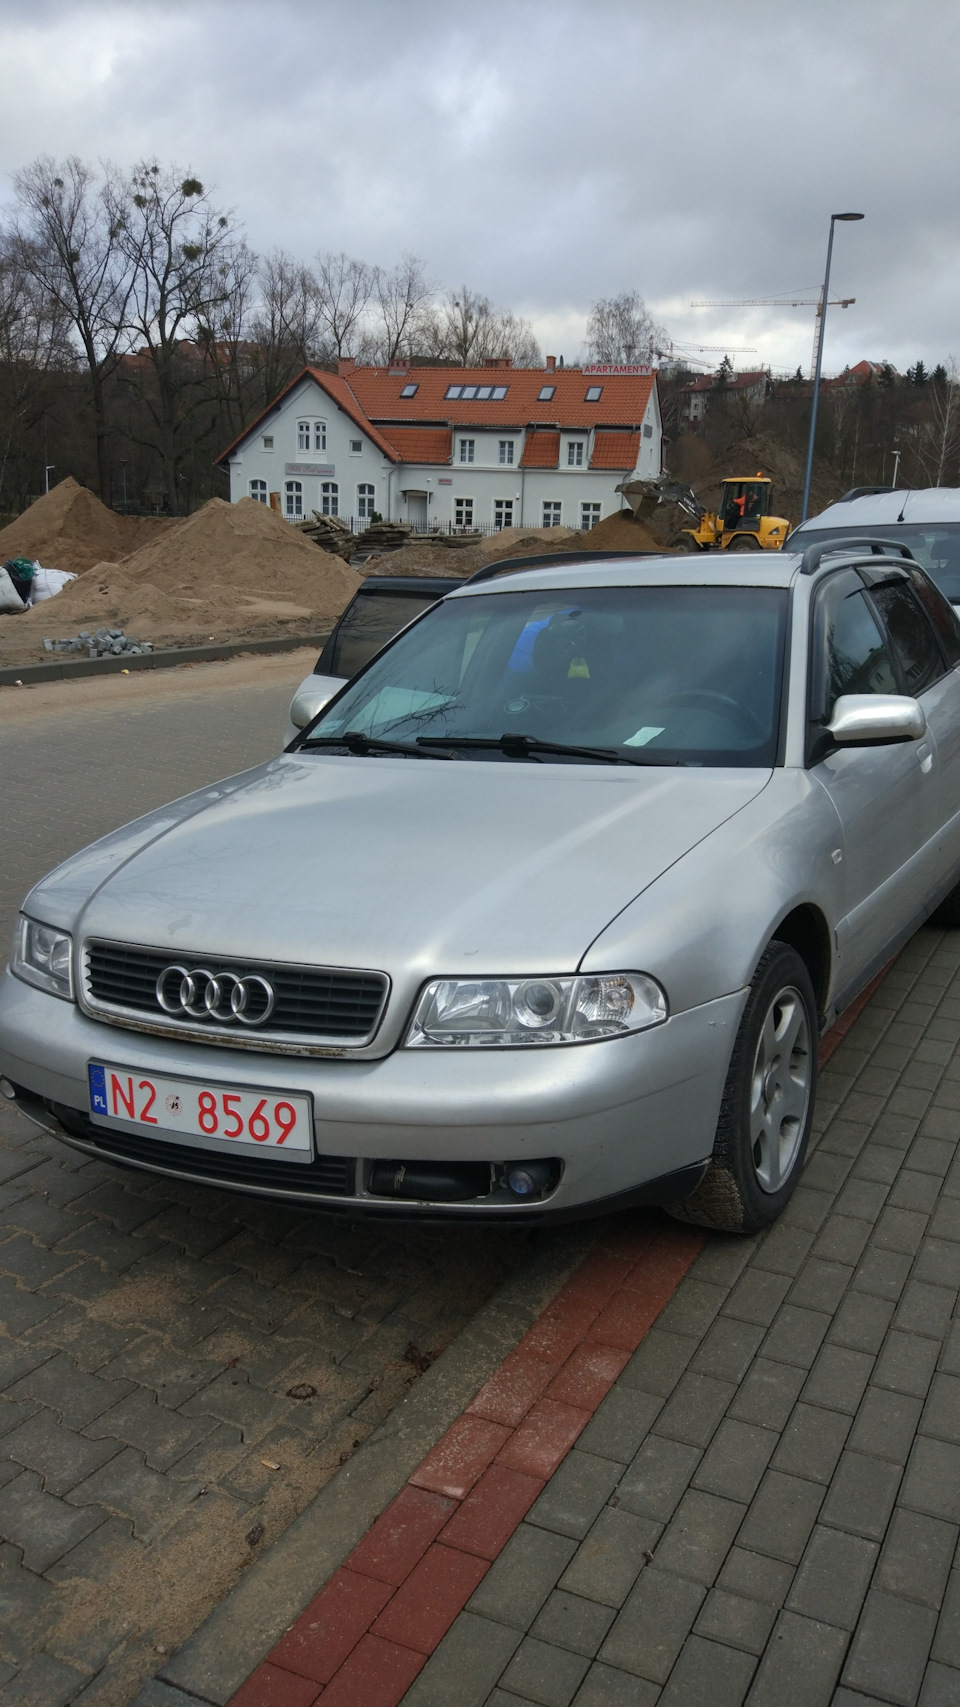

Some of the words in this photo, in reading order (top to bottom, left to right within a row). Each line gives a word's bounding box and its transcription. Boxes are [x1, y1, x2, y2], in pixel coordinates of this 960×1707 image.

[584, 365, 650, 374] APARTAMENTY
[94, 1095, 106, 1108] PL
[111, 1073, 158, 1124] N2
[198, 1091, 297, 1145] 8569
